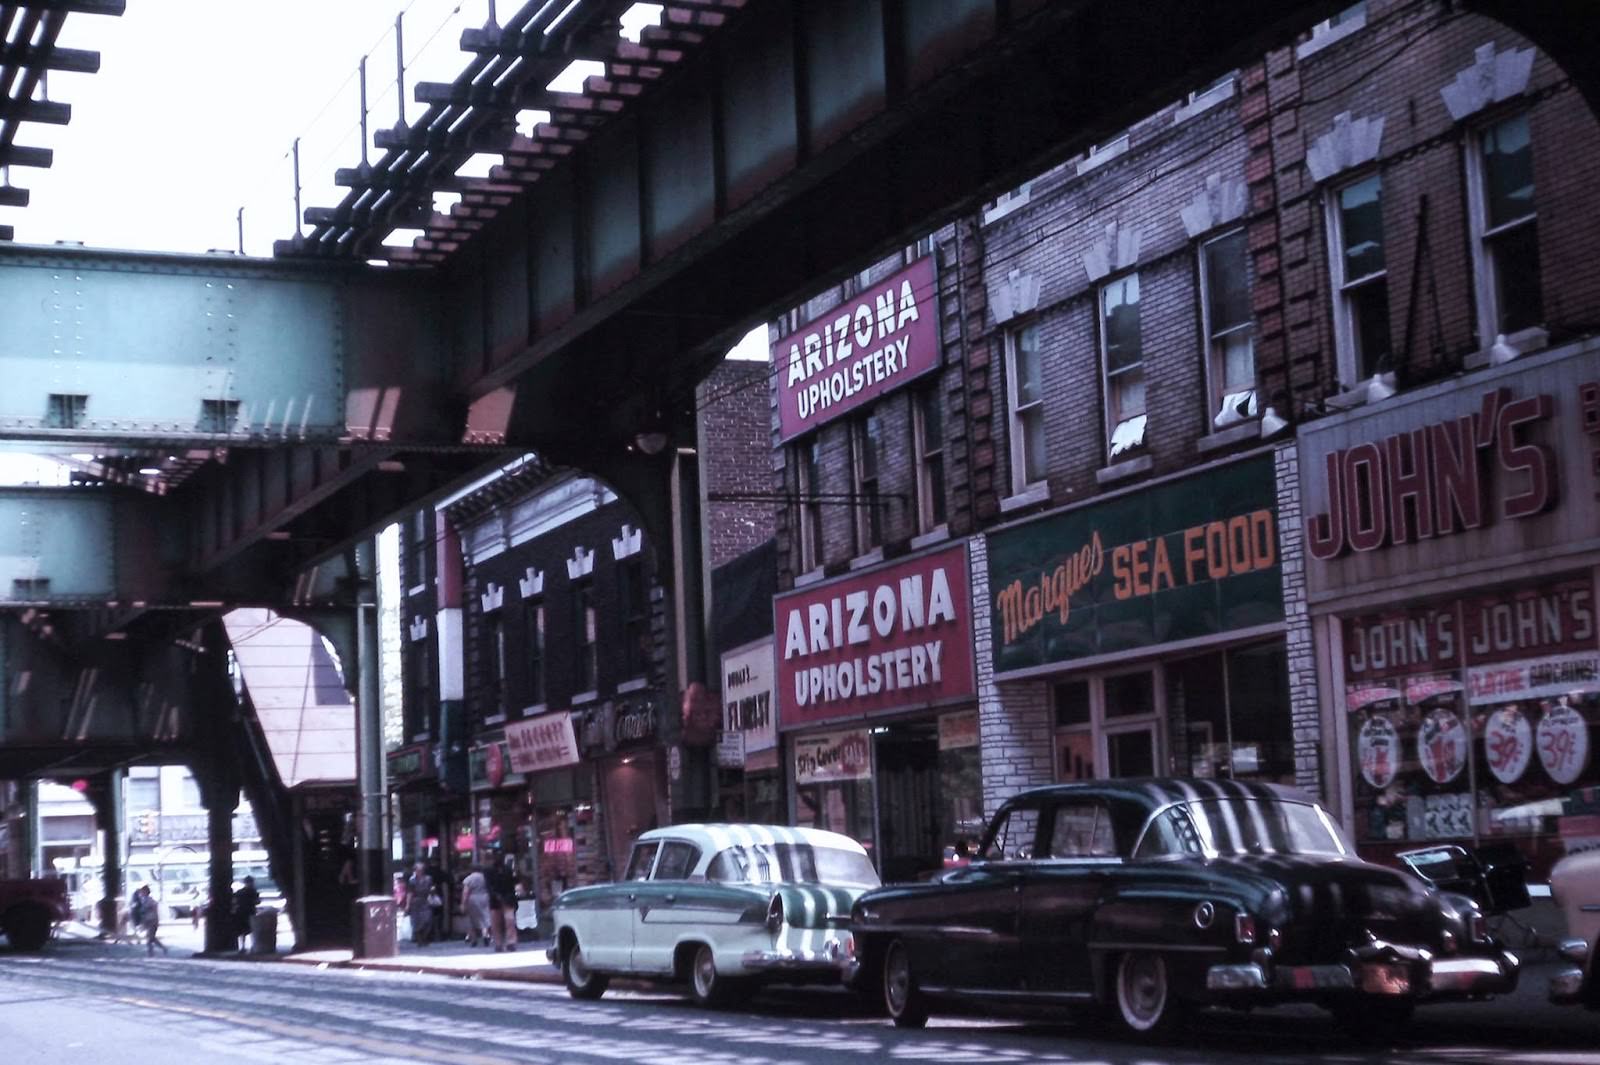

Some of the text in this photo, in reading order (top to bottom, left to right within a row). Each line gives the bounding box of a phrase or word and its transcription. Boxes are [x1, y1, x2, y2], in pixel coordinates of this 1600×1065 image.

[788, 280, 919, 388] ARIZONA
[798, 335, 910, 419] UPHOLSTERY
[1306, 388, 1555, 561] JOHN'S
[1112, 536, 1176, 600] SEA
[1184, 509, 1276, 585] FOOD
[784, 567, 957, 660] ARIZONA
[1350, 611, 1454, 673] JOHN'S
[1472, 593, 1592, 654] JOHN'S
[794, 640, 943, 707] UPHOLSTERY
